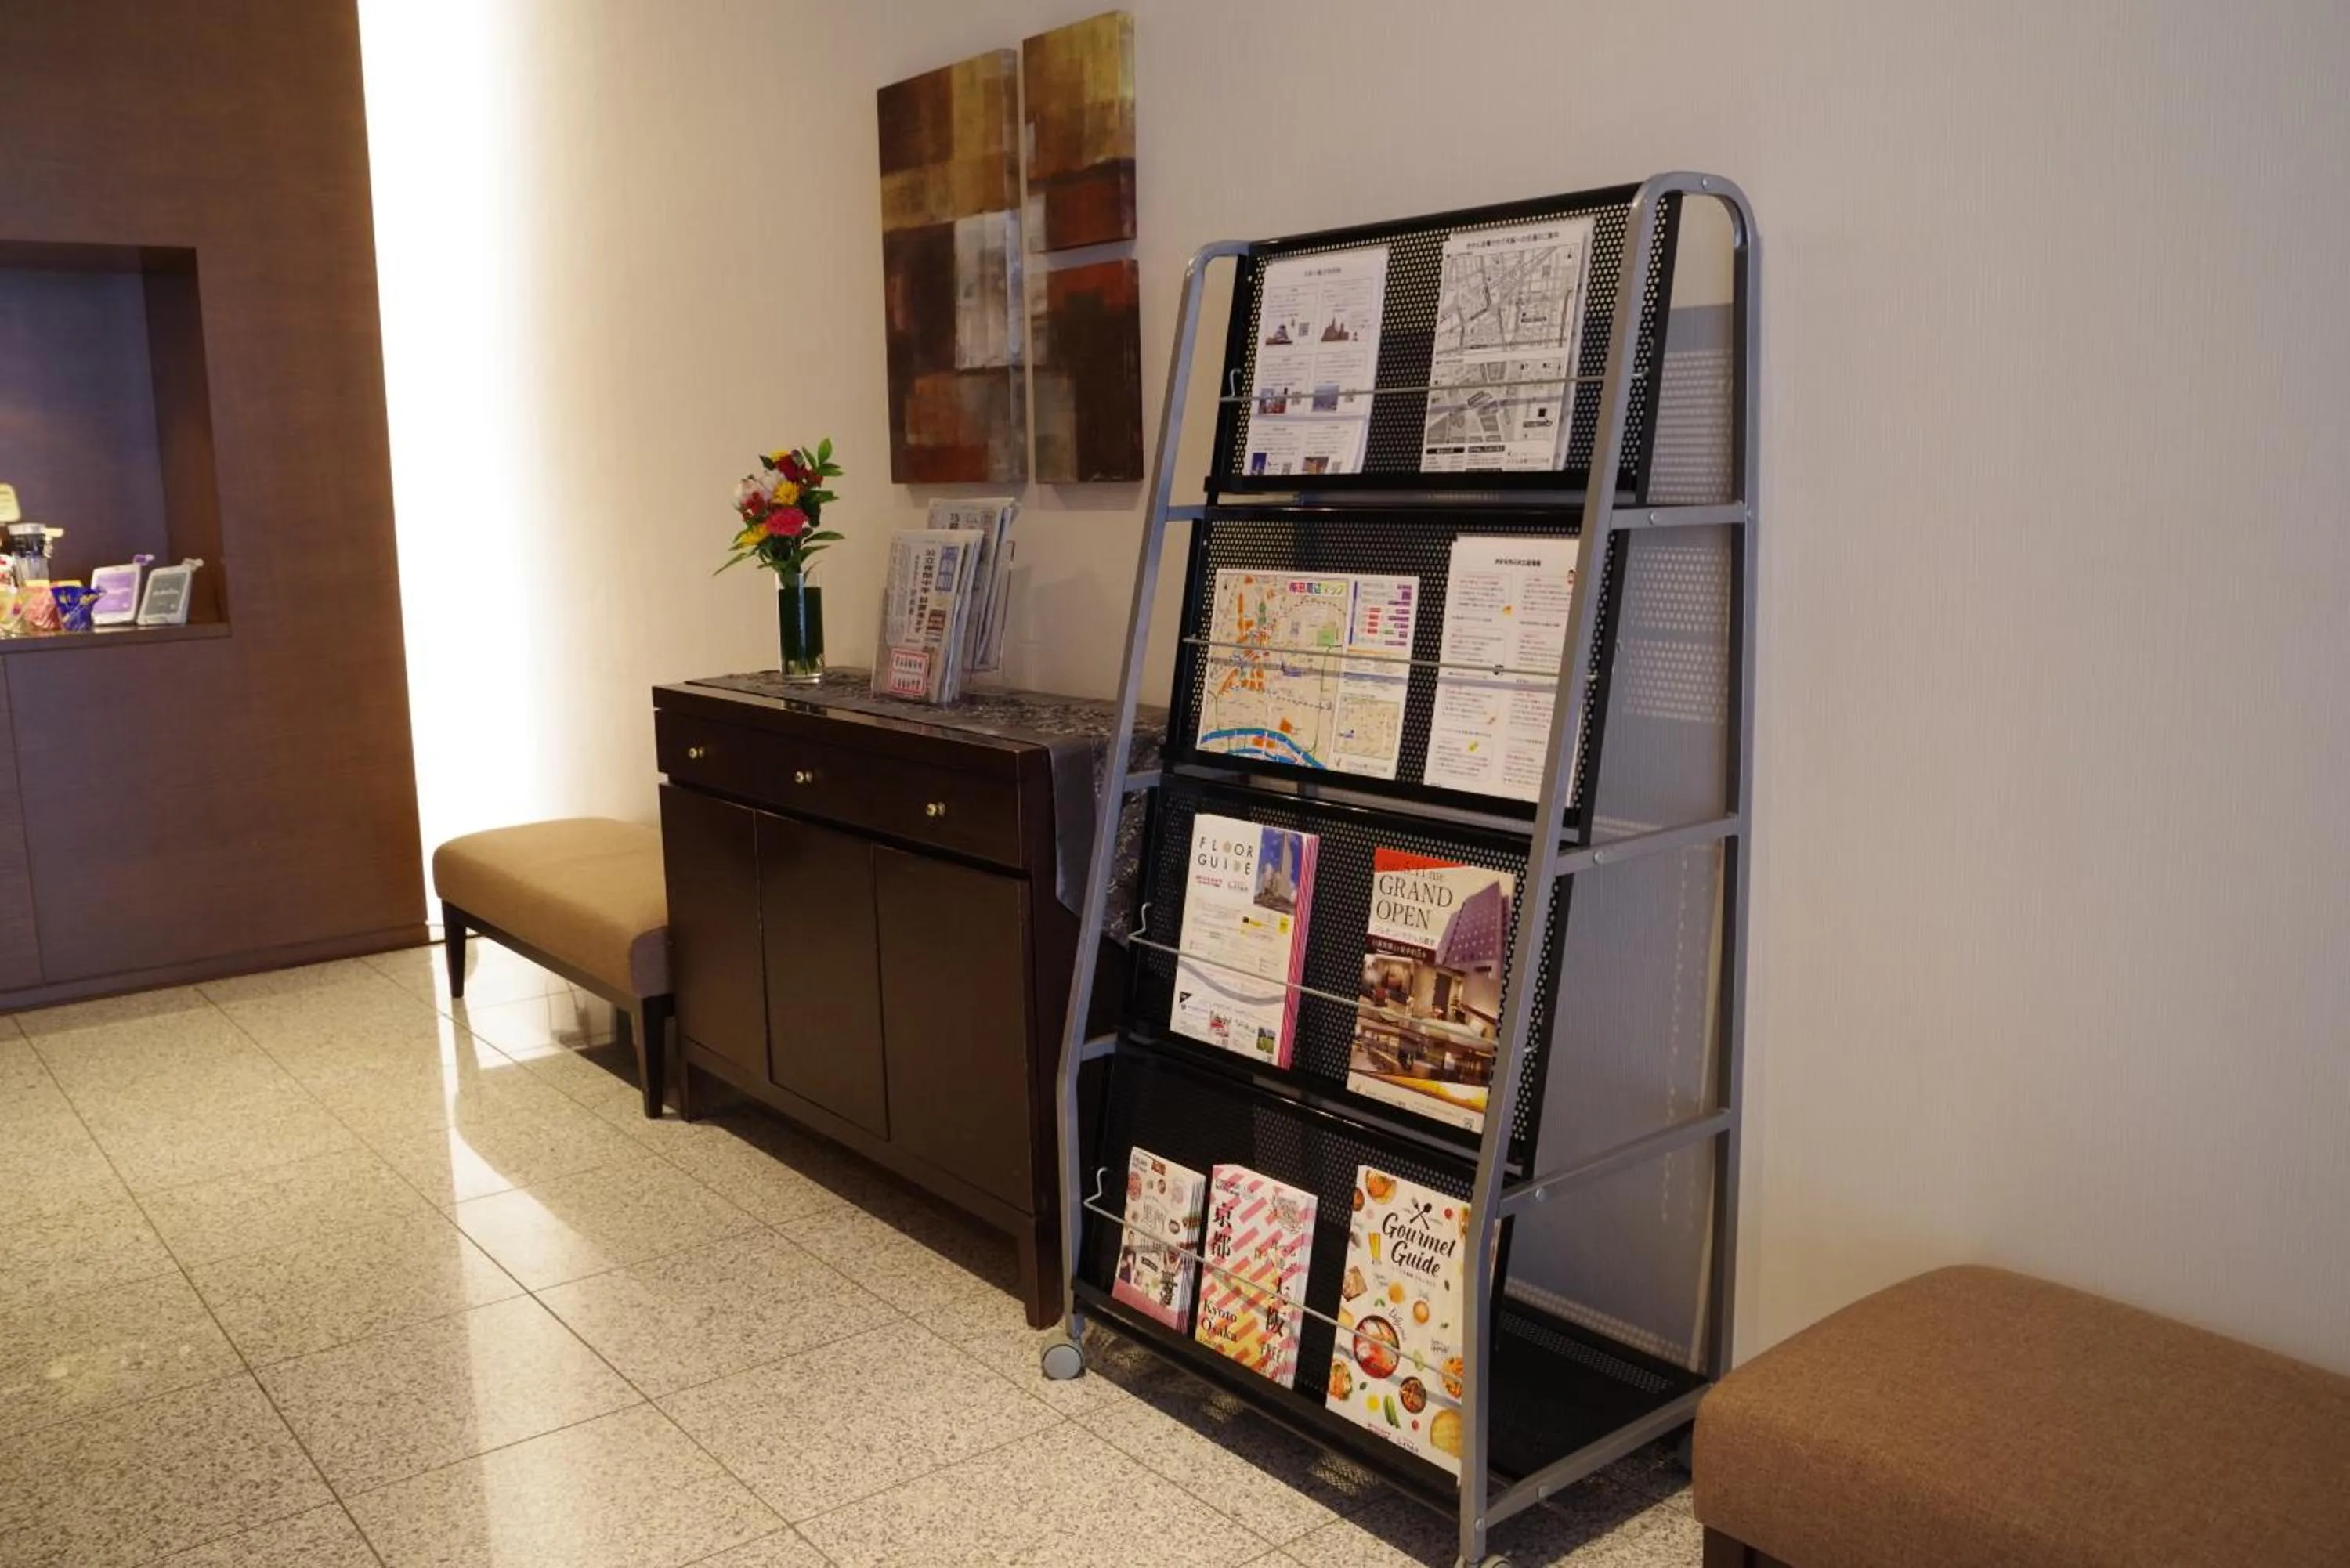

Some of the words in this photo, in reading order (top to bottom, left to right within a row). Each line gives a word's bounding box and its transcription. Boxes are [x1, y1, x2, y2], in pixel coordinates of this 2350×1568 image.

[1199, 836, 1254, 858] FLOOR
[1198, 853, 1251, 875] GUIDE
[1379, 873, 1453, 908] GRAND
[1376, 898, 1431, 930] OPEN
[1212, 1202, 1234, 1259] 京都
[1382, 1212, 1456, 1258] Gourmet
[1390, 1240, 1441, 1278] Guide
[1203, 1298, 1237, 1323] Kyoto
[1201, 1317, 1238, 1343] Osaka
